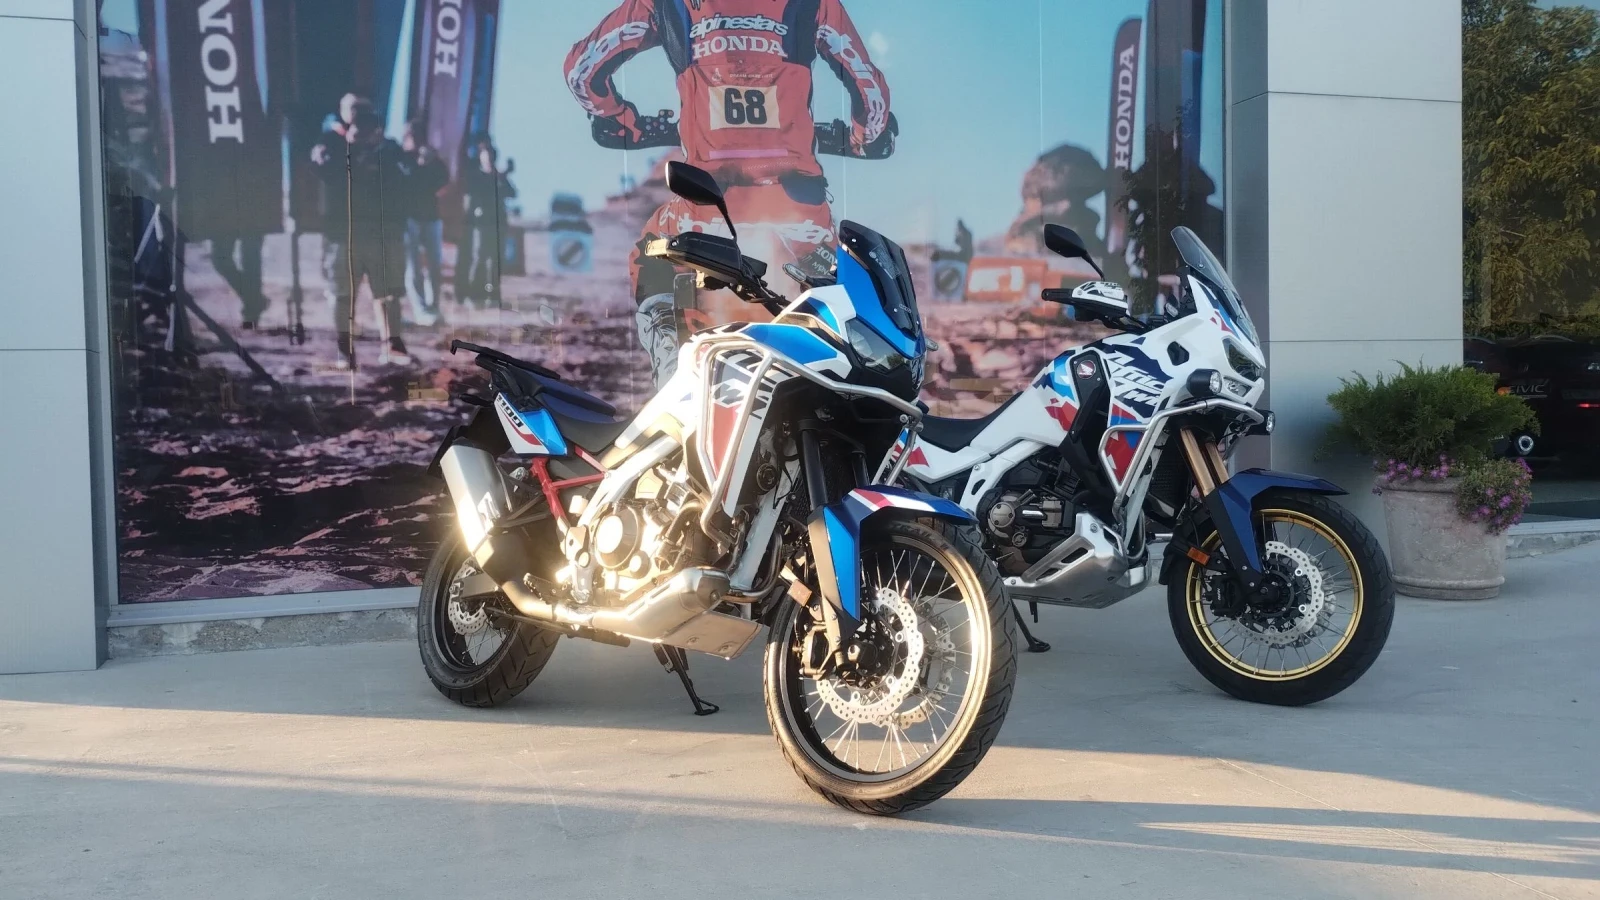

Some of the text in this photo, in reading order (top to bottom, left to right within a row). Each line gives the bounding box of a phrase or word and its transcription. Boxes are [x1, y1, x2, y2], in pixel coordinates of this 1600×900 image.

[433, 0, 464, 78] HO
[689, 14, 788, 39] alpinestars
[692, 36, 788, 60] HONDA
[724, 87, 768, 125] 68
[1114, 44, 1135, 170] HONDA
